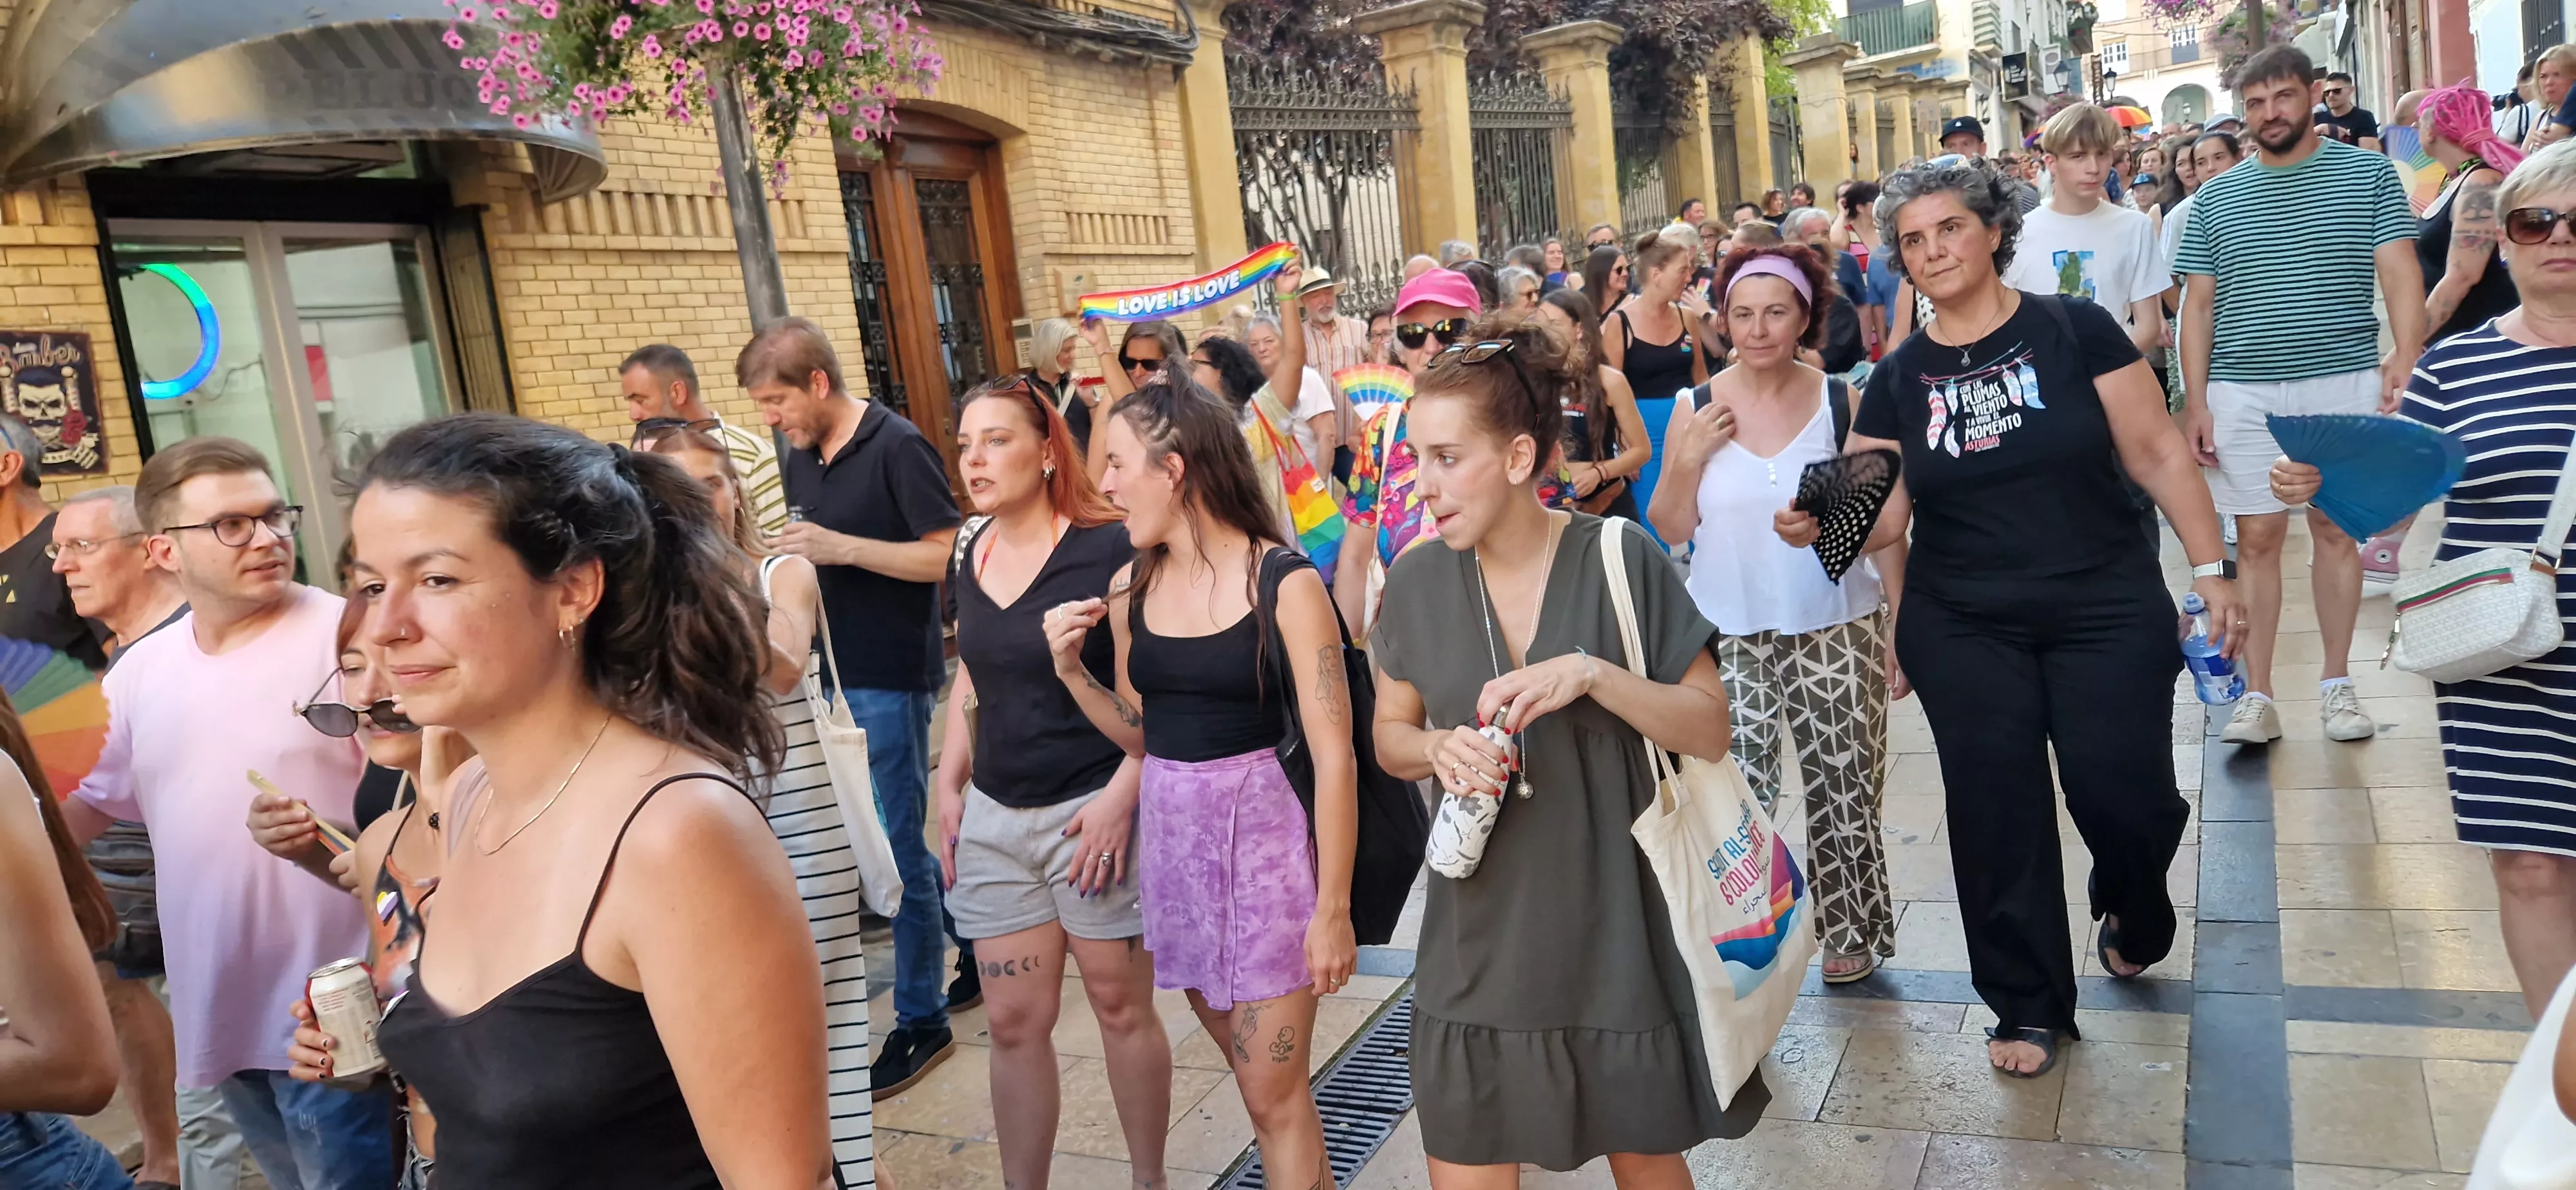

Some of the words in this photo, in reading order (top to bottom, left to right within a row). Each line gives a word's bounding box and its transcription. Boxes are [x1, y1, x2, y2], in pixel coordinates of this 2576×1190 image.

[1117, 292, 1168, 316] LOVE
[1172, 287, 1191, 306] IS
[1193, 269, 1240, 301] LOVE
[1960, 384, 1971, 394] CON
[1973, 379, 1984, 390] LAS
[1961, 381, 2001, 406] PLUMAS
[1972, 393, 2008, 417] VIENTO
[1993, 411, 2000, 420] EL
[1965, 412, 2022, 442] MOMENTO
[1965, 435, 2000, 451] ASTURIAS
